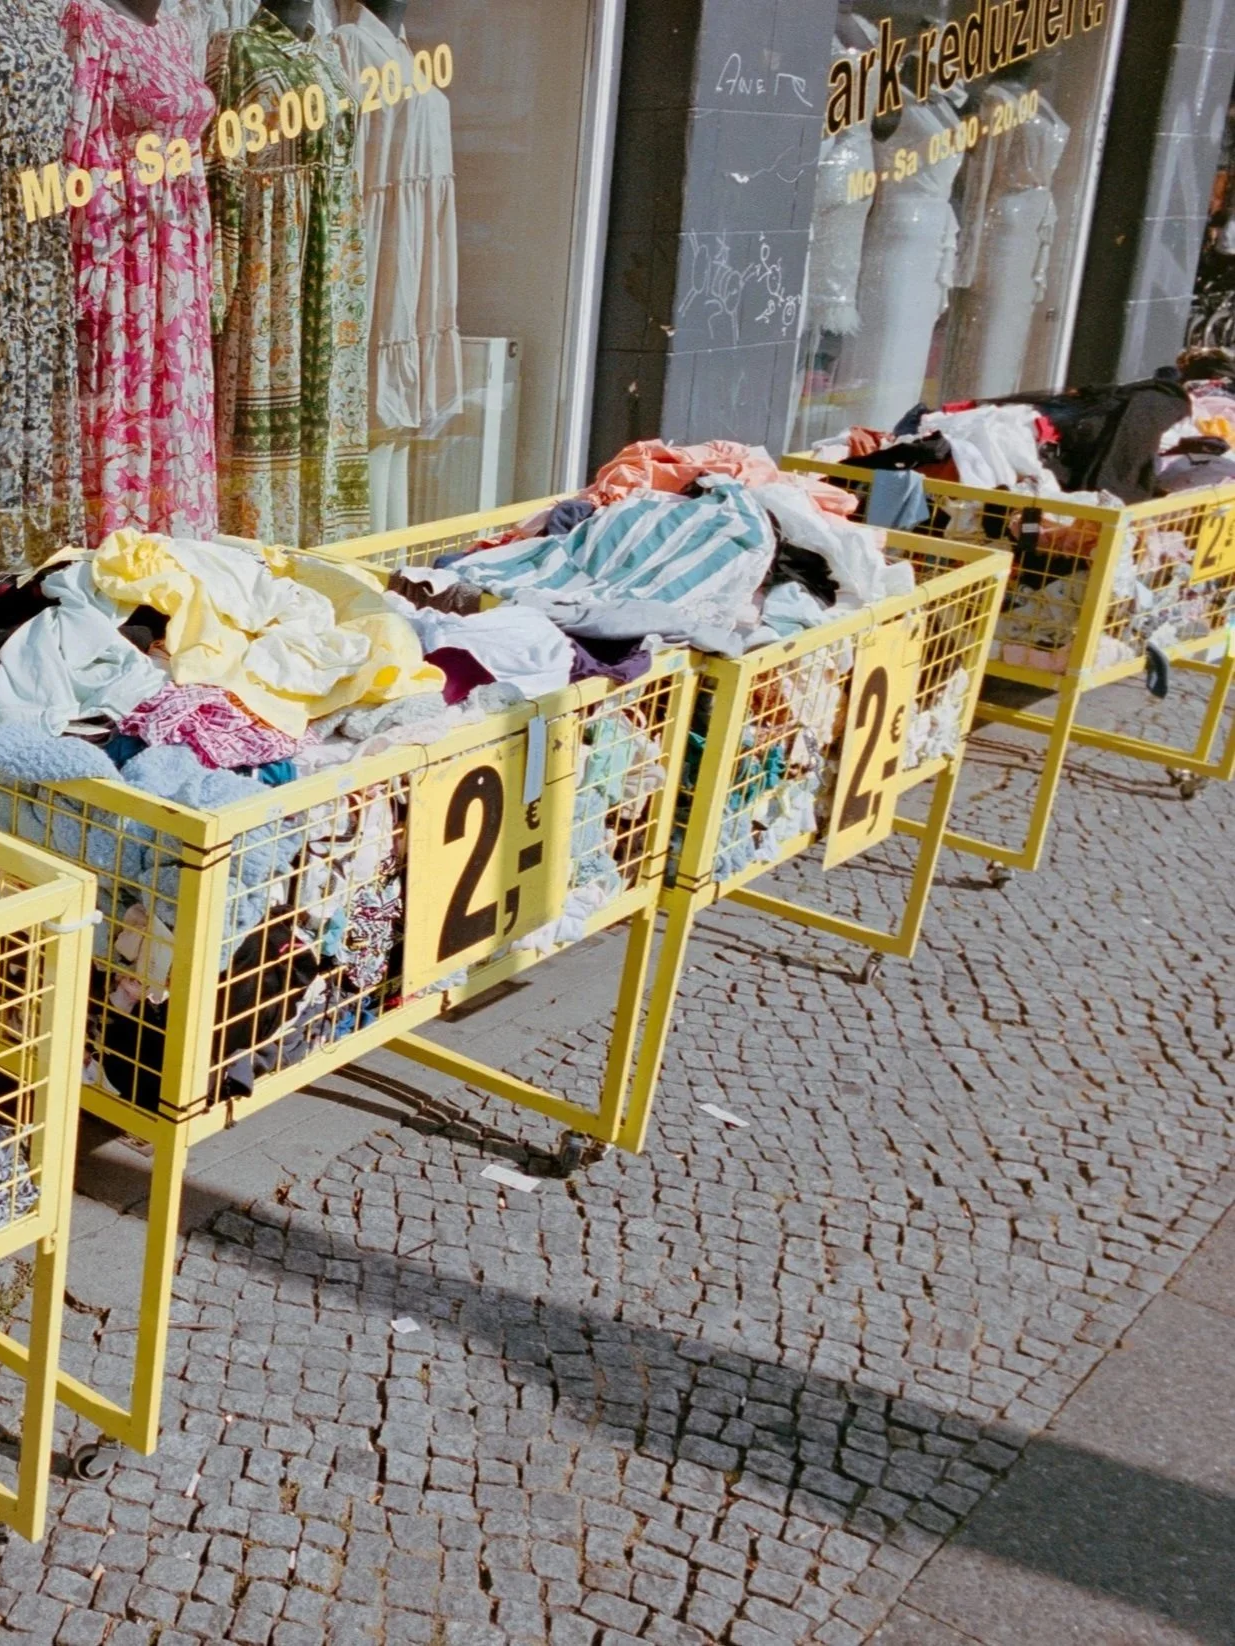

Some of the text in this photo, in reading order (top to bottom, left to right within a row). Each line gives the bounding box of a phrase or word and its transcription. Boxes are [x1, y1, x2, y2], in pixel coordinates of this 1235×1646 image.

[20, 162, 92, 222] Mo
[107, 171, 122, 183] -
[135, 133, 192, 186] Sa
[217, 84, 326, 160] 09.00
[359, 43, 453, 114] 20.00
[821, 17, 906, 137] ark
[847, 169, 876, 203] Mo
[893, 148, 918, 182] Sa
[992, 89, 1039, 137] 20.00
[889, 704, 906, 744] €
[526, 798, 542, 830] €
